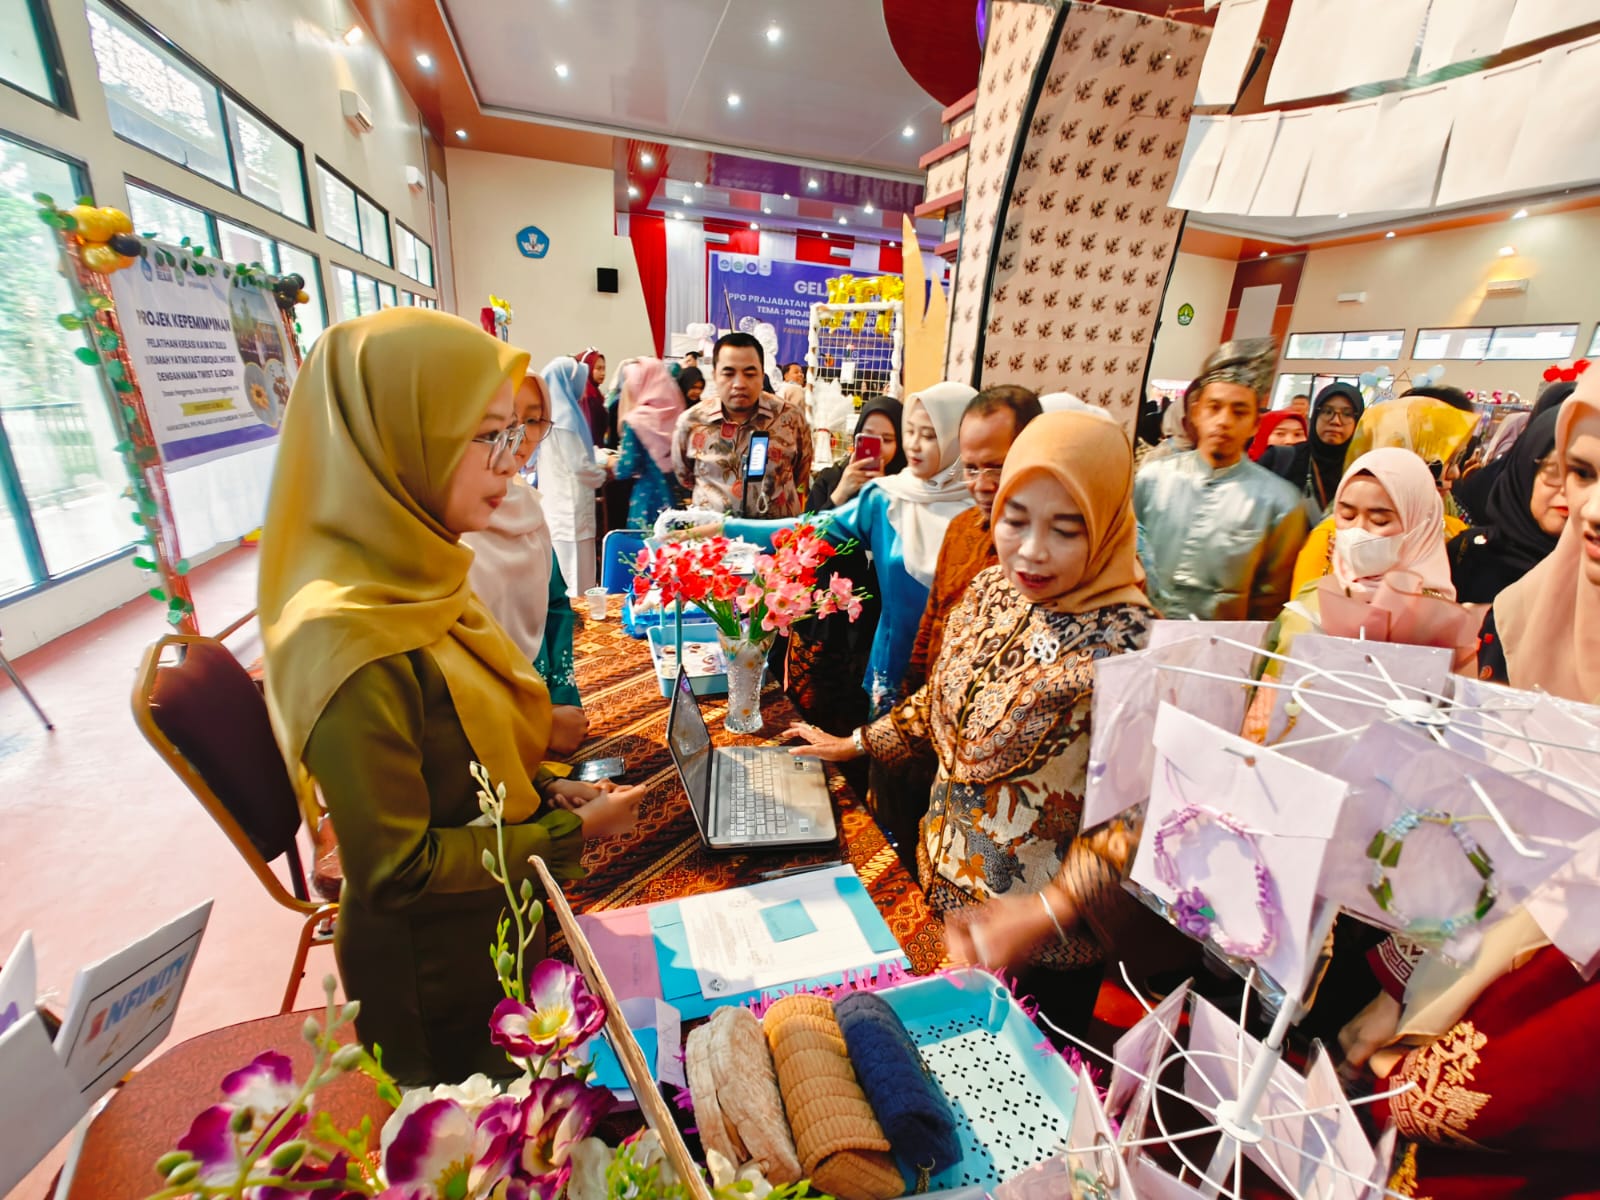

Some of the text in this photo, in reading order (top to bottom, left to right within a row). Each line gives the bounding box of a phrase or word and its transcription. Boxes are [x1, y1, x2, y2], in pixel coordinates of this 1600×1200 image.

[794, 280, 827, 297] GEL
[728, 292, 748, 302] PPG
[748, 295, 807, 308] PRAJABATAN
[757, 305, 780, 315] TEMA
[136, 309, 231, 332] PROJEK KEPEMIMPINAN
